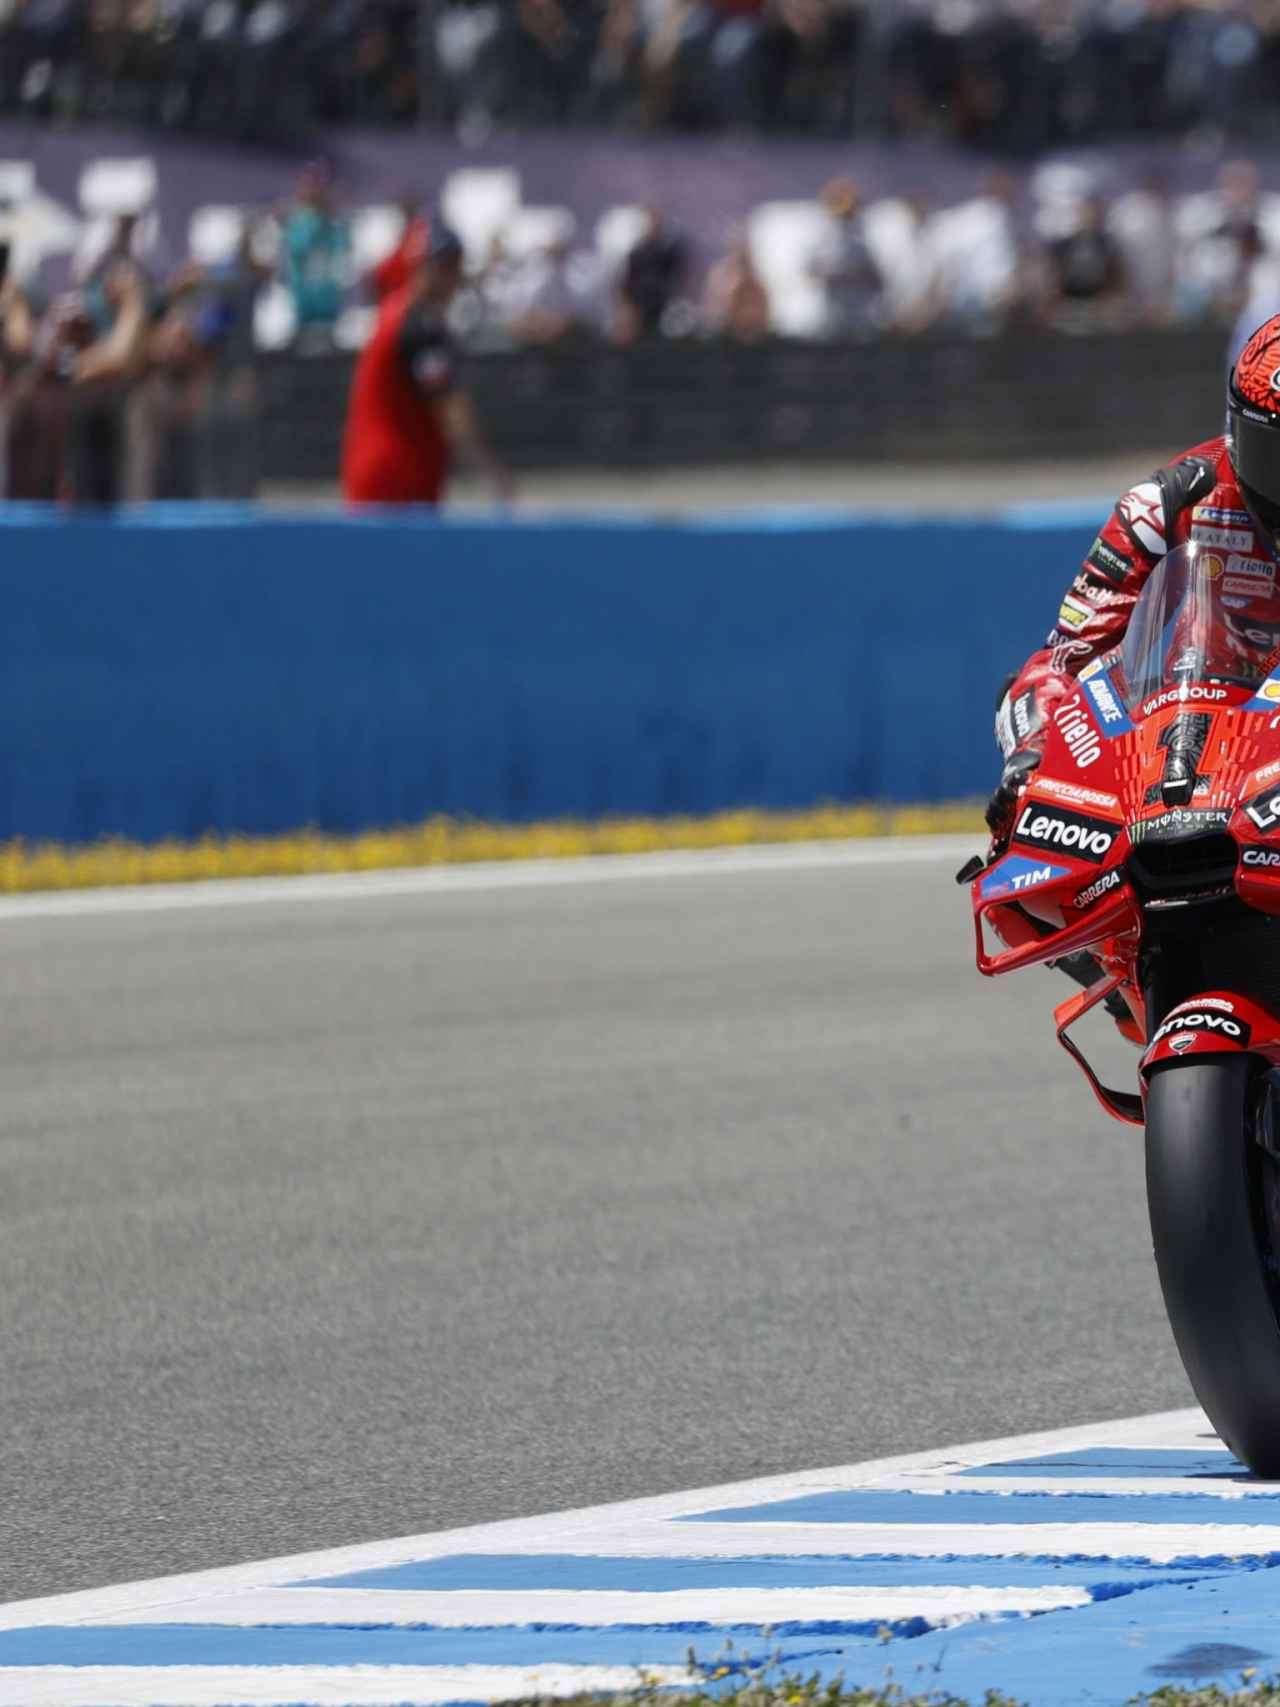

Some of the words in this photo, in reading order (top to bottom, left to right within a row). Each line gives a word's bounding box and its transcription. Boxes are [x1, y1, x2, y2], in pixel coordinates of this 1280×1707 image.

[1016, 806, 1112, 855] Lenovo
[1146, 810, 1229, 831] MONSTER
[1011, 866, 1052, 890] TIM
[1073, 870, 1121, 909] CARRERA
